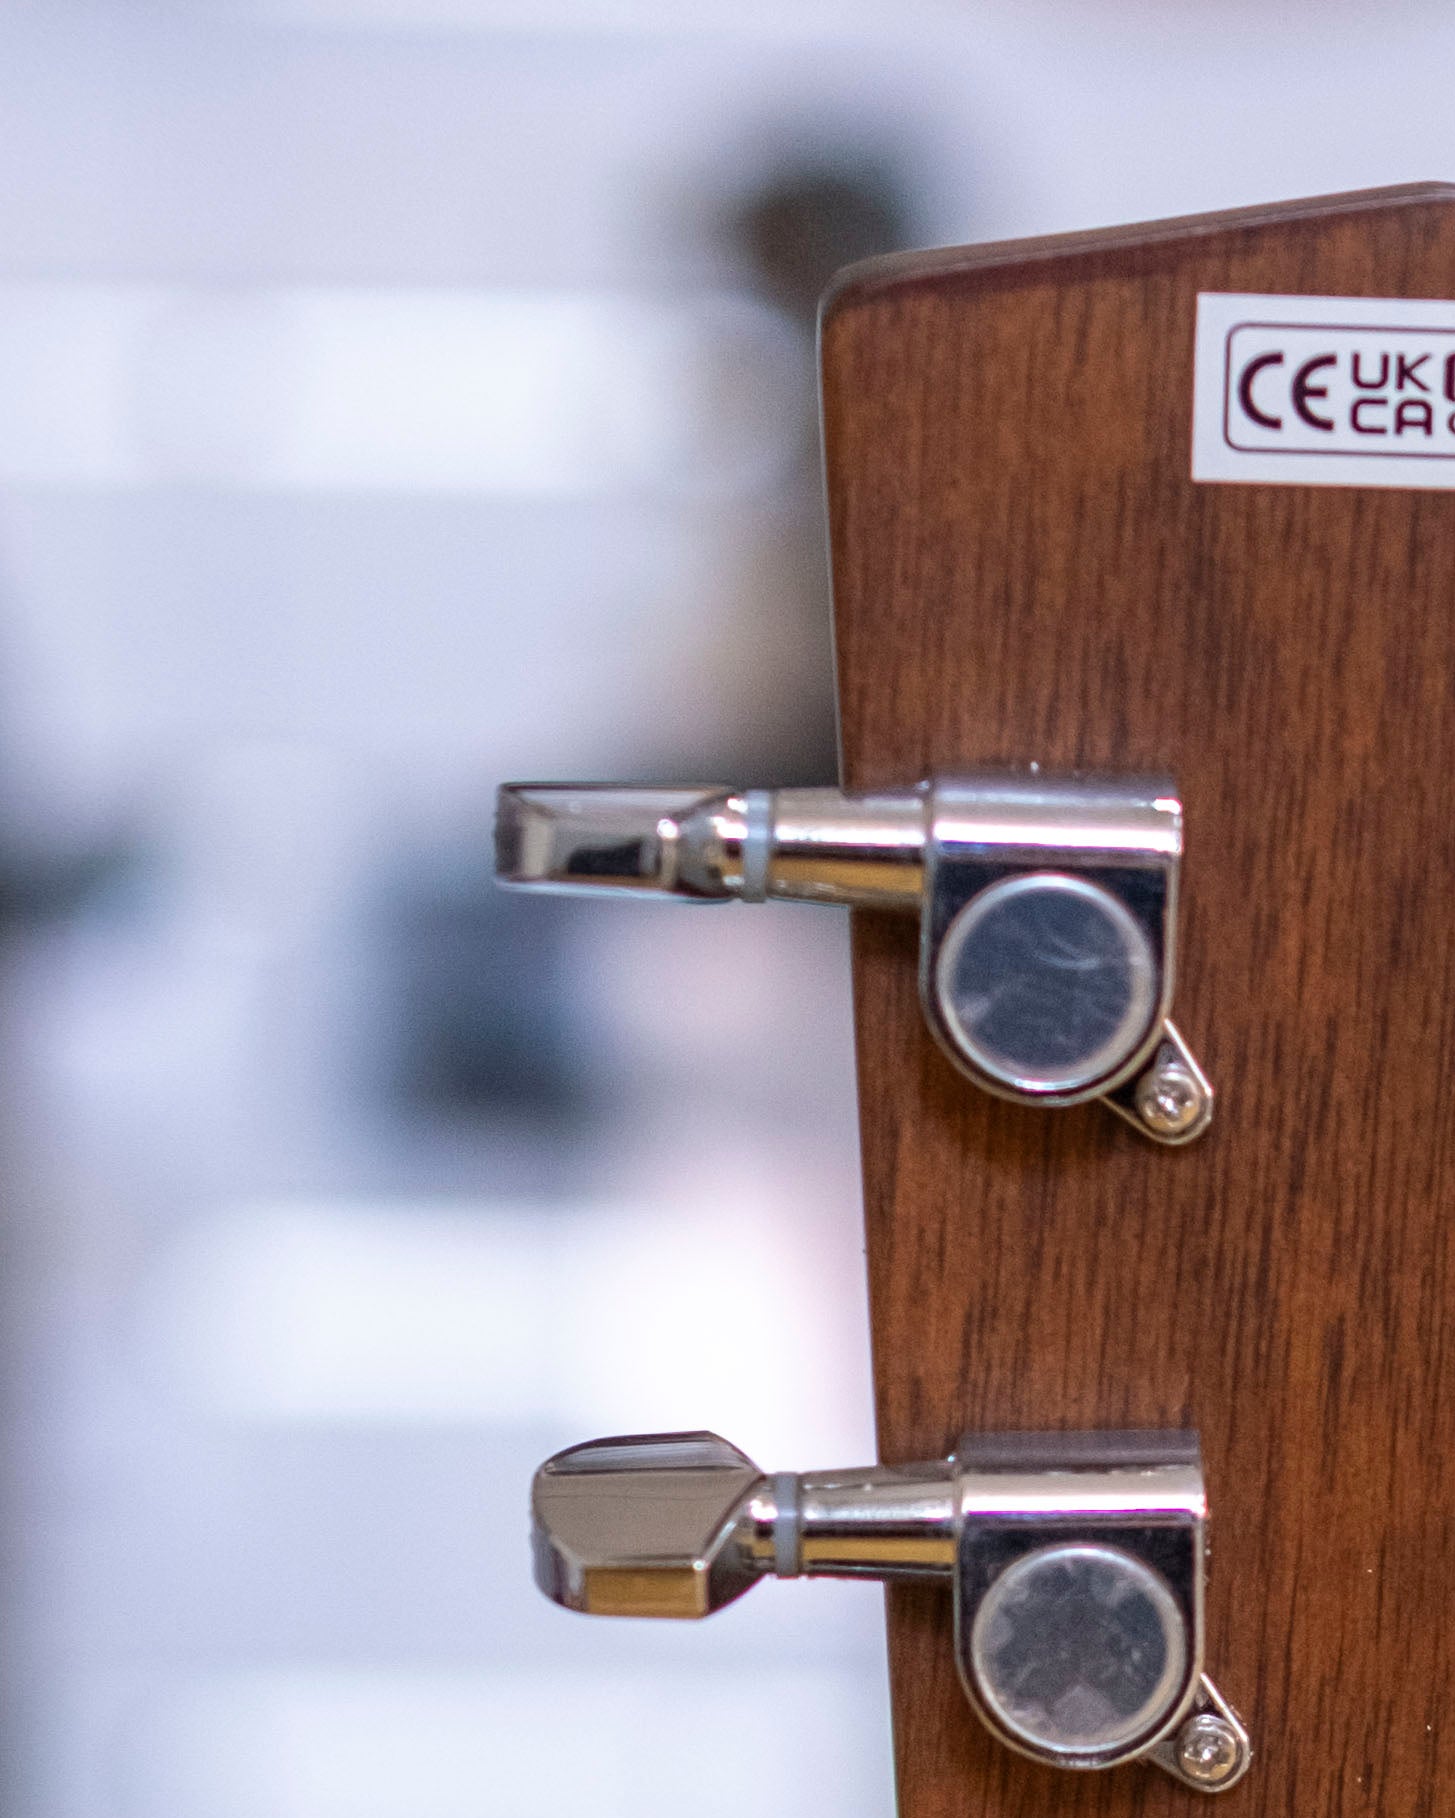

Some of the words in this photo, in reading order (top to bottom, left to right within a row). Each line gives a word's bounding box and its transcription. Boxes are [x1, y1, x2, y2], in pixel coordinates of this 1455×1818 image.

[1238, 351, 1337, 431] CE
[1352, 353, 1432, 391] UK
[1351, 399, 1433, 435] CA
